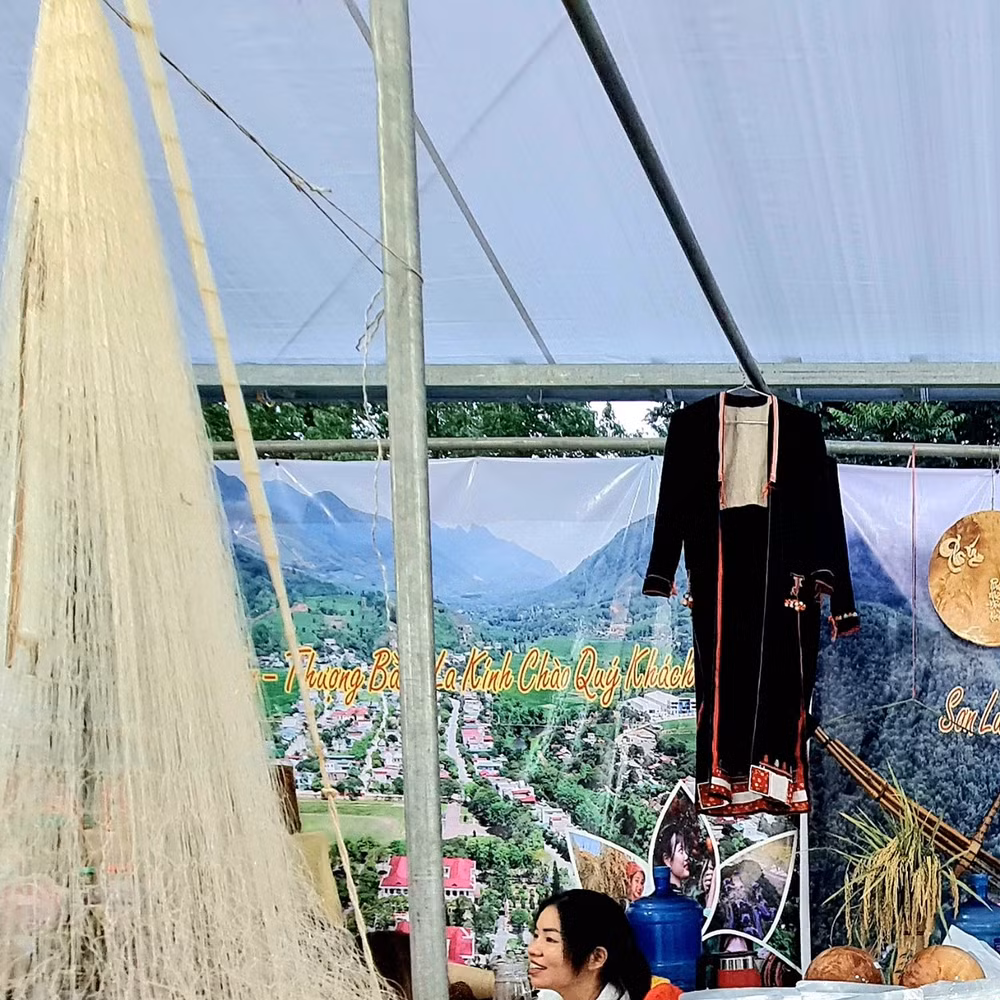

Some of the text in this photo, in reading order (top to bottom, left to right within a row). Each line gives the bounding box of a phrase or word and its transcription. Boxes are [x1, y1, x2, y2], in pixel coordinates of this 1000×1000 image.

[518, 647, 571, 694] Chào
[575, 645, 622, 708] Quý
[625, 644, 696, 692] Khách
